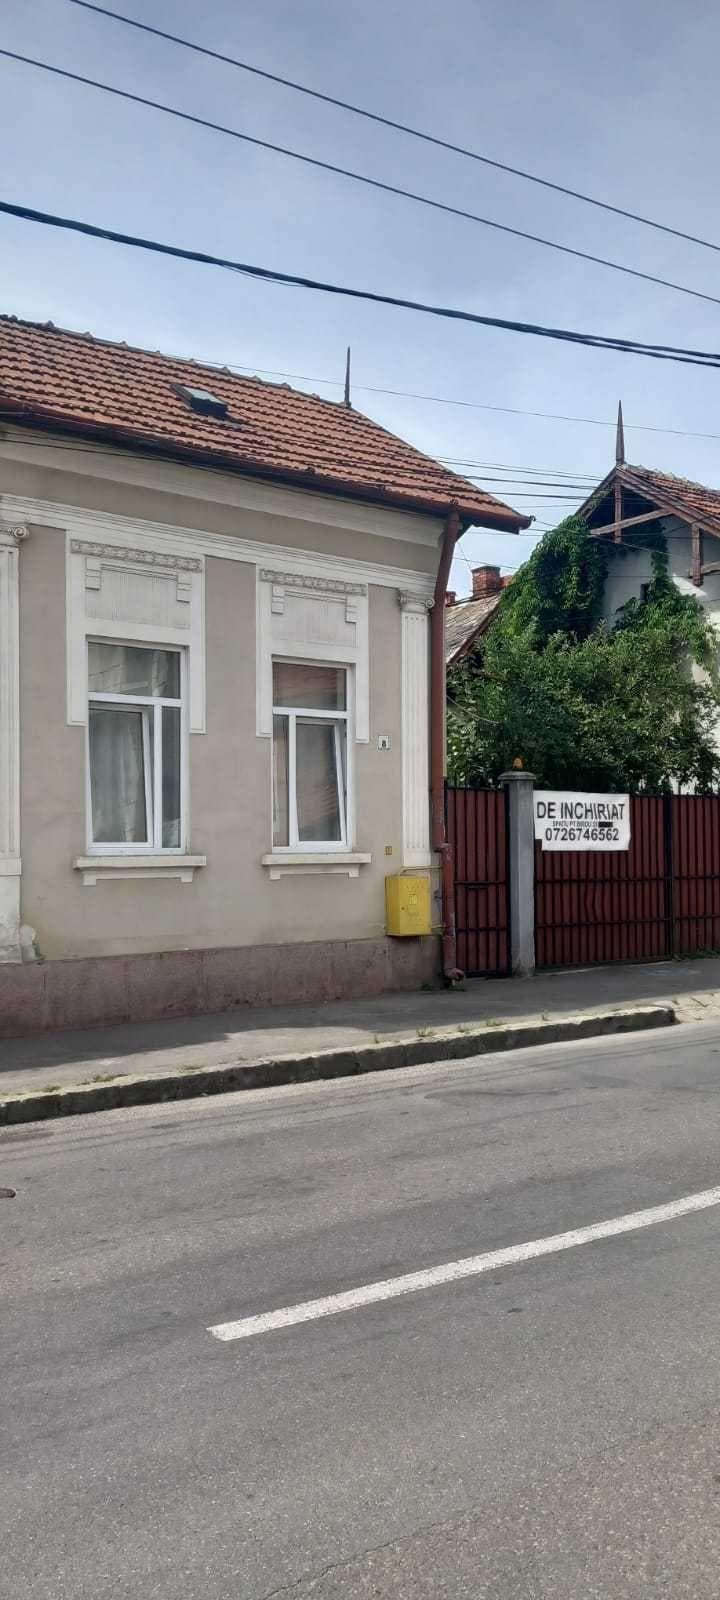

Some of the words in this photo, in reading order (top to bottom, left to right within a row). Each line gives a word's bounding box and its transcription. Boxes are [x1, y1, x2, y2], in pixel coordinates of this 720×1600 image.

[537, 802, 556, 818] DE
[561, 802, 625, 820] INCHIRIAT
[545, 828, 619, 841] 0726746562
